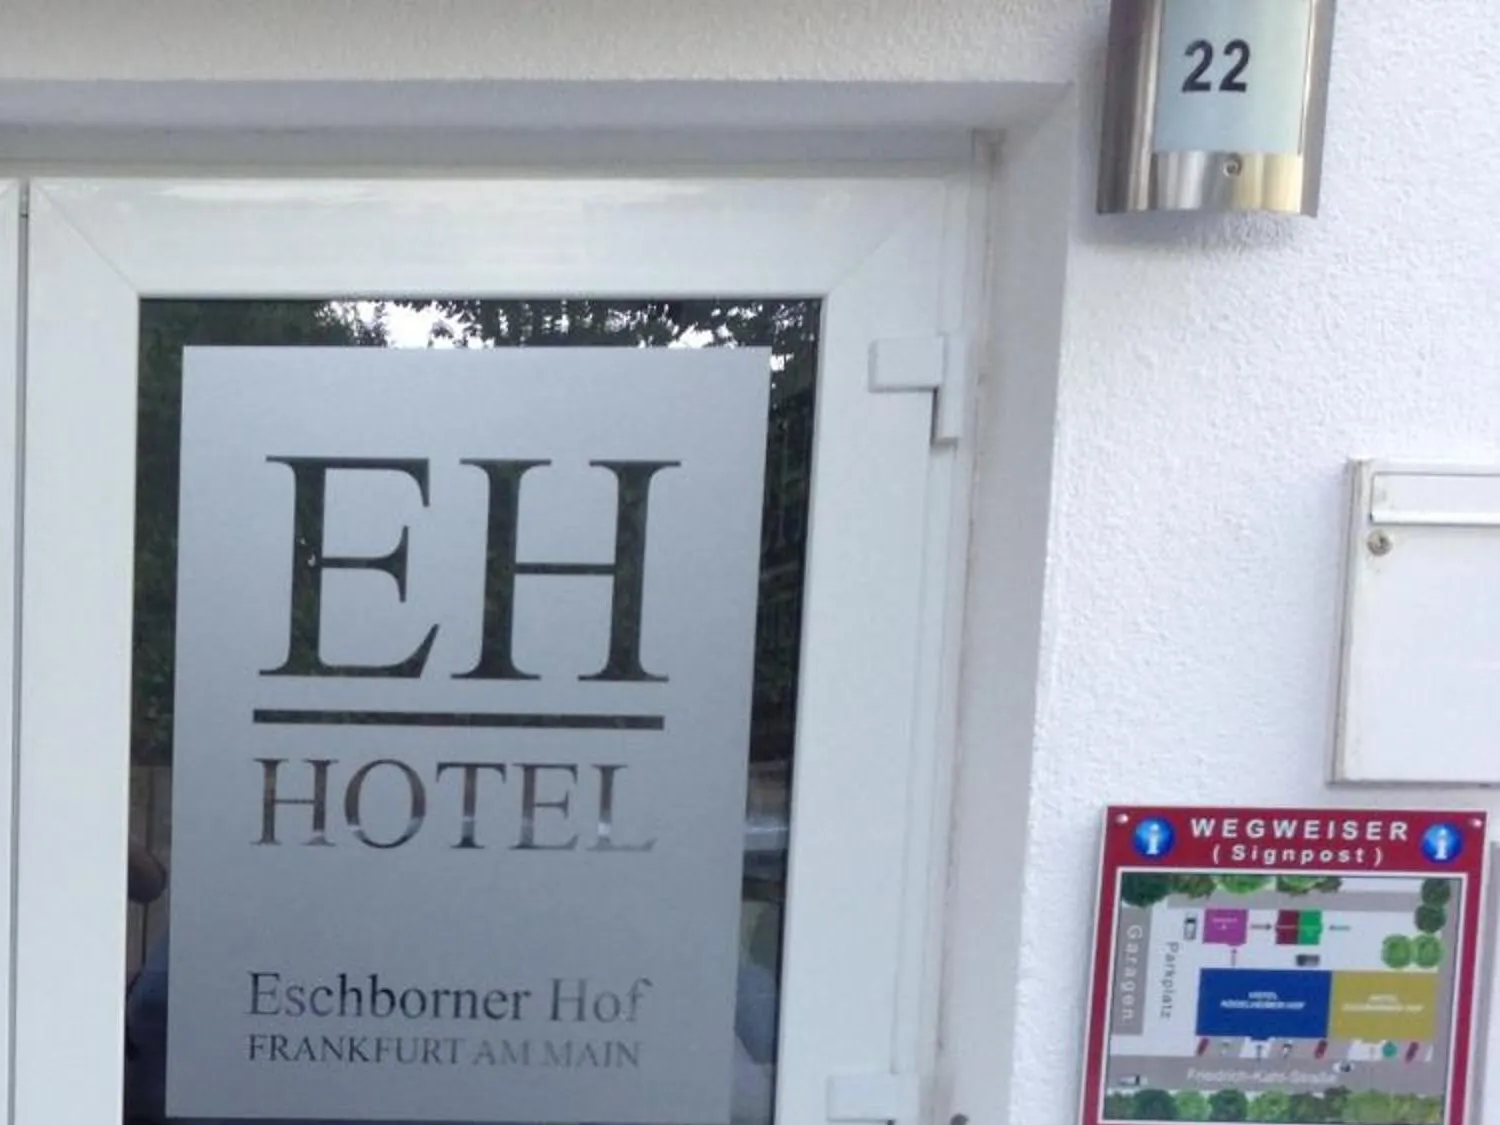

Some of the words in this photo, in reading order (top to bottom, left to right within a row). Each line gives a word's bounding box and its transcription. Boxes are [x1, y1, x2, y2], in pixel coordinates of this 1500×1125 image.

[1181, 38, 1251, 93] 22
[258, 455, 682, 683] EH
[249, 757, 658, 853] HOTEL
[1189, 817, 1409, 841] WEGWEISER
[246, 970, 532, 1023] Eschborner
[547, 977, 653, 1025] Hof
[1121, 924, 1143, 1020] Garagen
[1160, 941, 1180, 1019] Parkplatz
[247, 1033, 467, 1064] FRANKFURT
[471, 1038, 531, 1067] AM
[540, 1039, 643, 1069] MAIN
